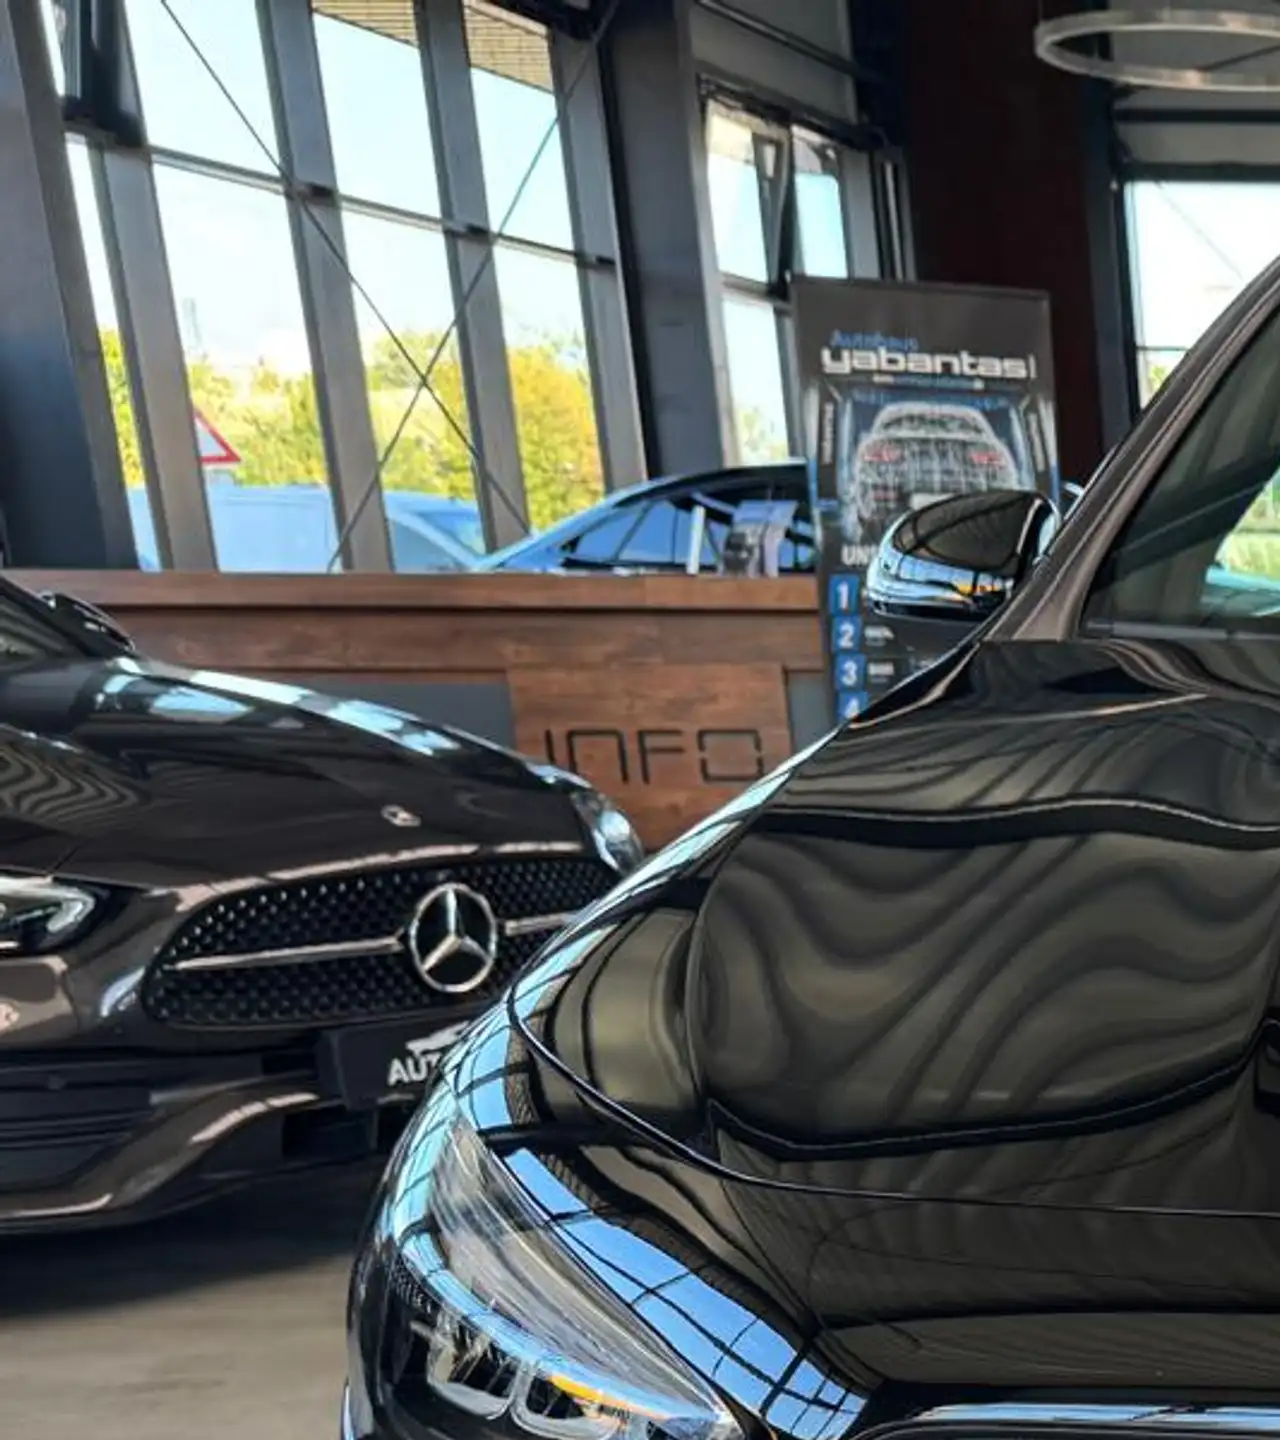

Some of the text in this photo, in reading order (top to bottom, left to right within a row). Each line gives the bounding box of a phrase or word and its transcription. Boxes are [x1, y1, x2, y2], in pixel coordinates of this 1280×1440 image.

[821, 347, 1028, 379] yabantas
[836, 581, 850, 610] 1
[838, 622, 855, 648] 2
[841, 660, 858, 686] 3
[545, 729, 764, 783] INFO
